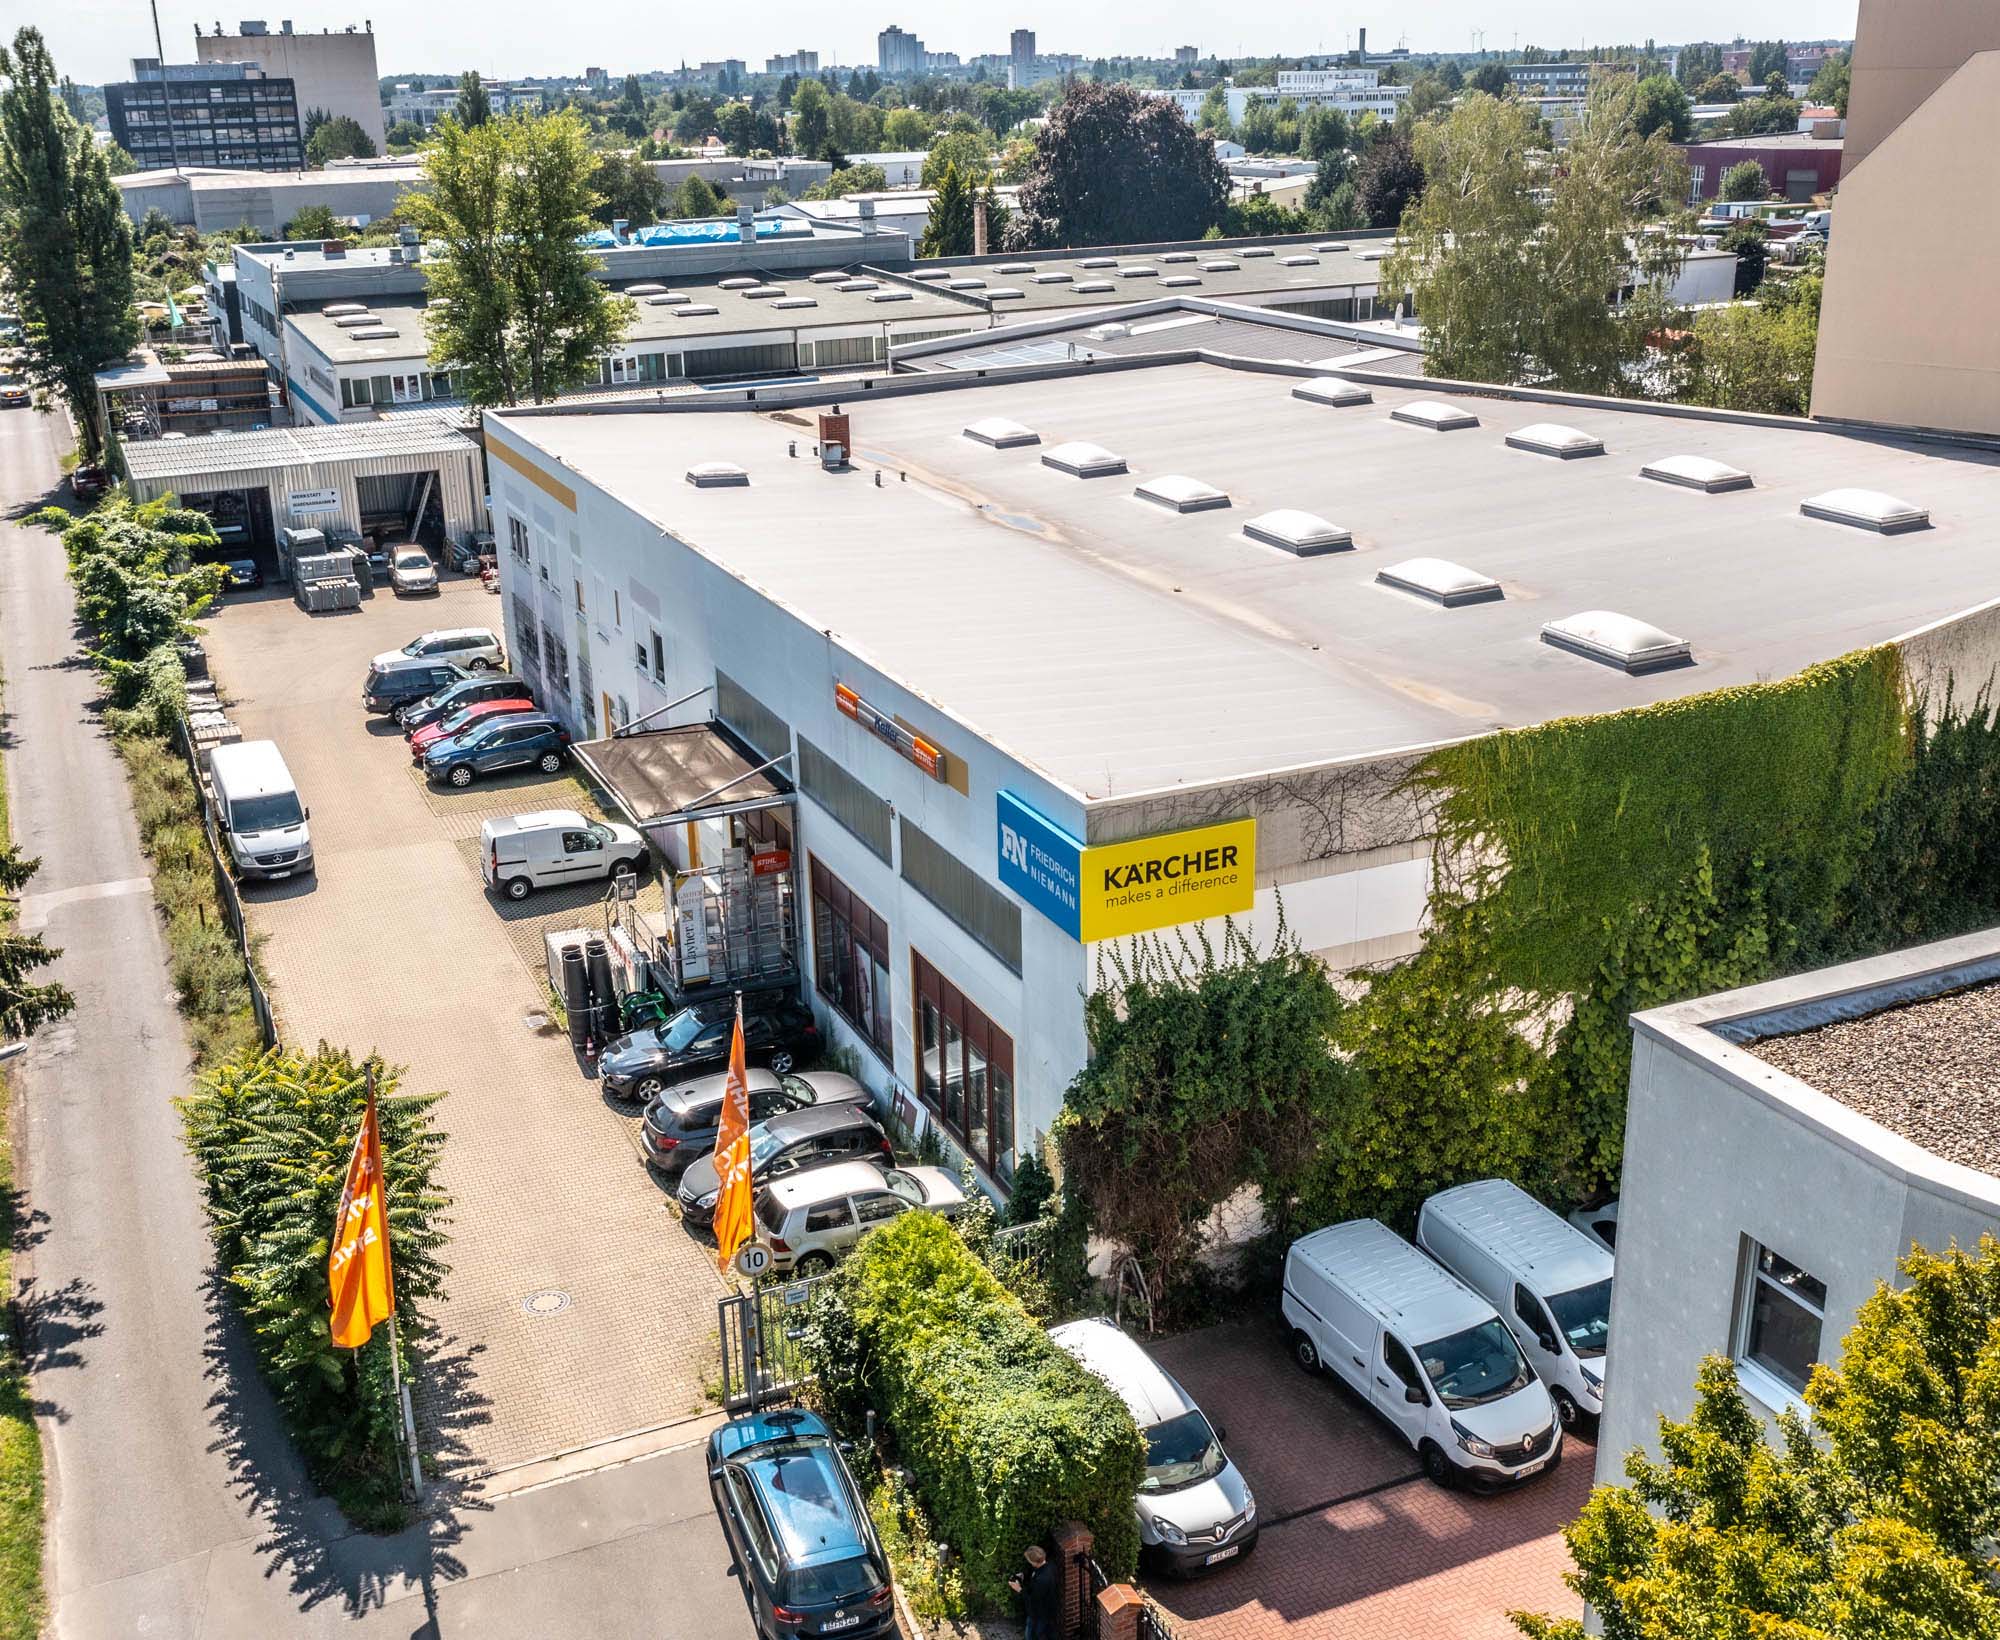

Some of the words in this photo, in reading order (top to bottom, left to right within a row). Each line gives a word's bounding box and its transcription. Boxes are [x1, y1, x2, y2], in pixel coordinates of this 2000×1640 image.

[757, 857, 777, 866] STIHL
[1030, 844, 1075, 888] FRIEDRICH
[1103, 845, 1238, 891] KÄRCHER
[1030, 867, 1075, 911] NIEMANN
[1106, 886, 1151, 909] makes
[1156, 888, 1164, 898] a
[1168, 873, 1238, 896] difference
[744, 1251, 764, 1268] 10
